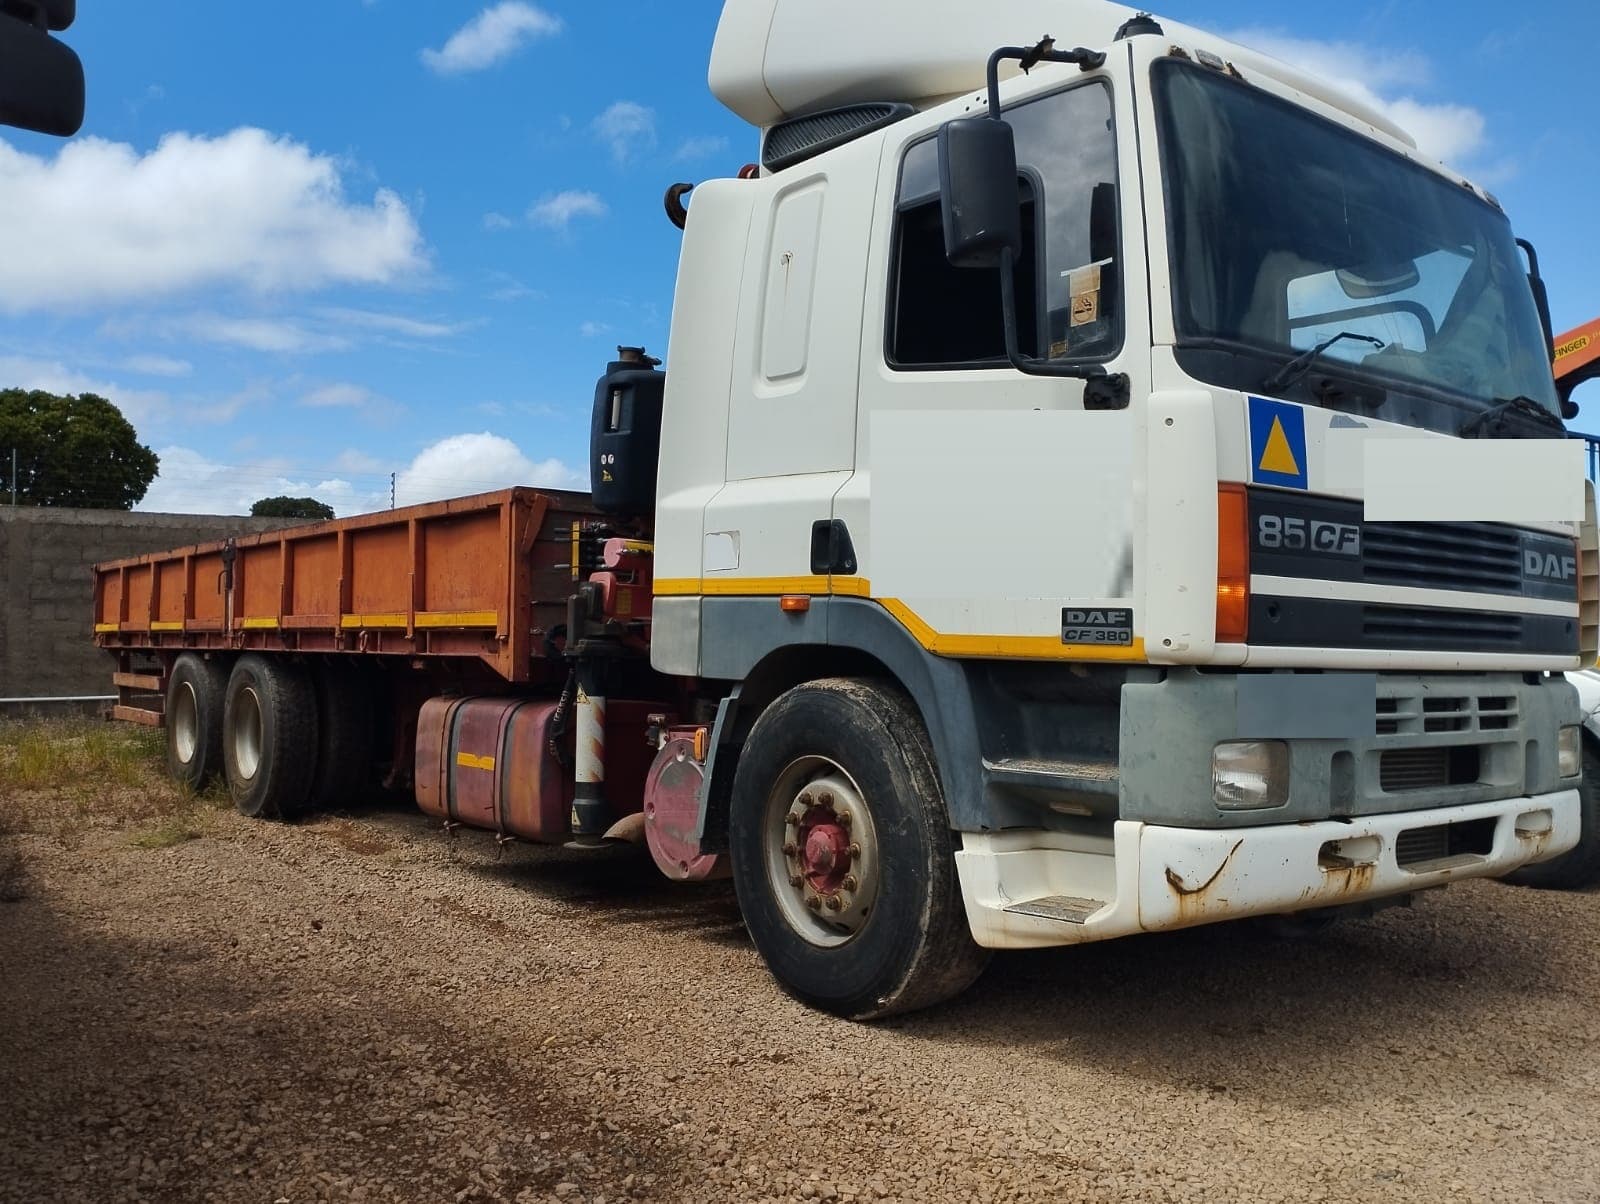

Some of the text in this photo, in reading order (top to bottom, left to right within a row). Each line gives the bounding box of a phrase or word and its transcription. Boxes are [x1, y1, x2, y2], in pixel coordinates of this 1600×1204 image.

[1524, 550, 1576, 580] DAF
[1066, 611, 1126, 624] DAF
[1064, 629, 1129, 642] CF 380
